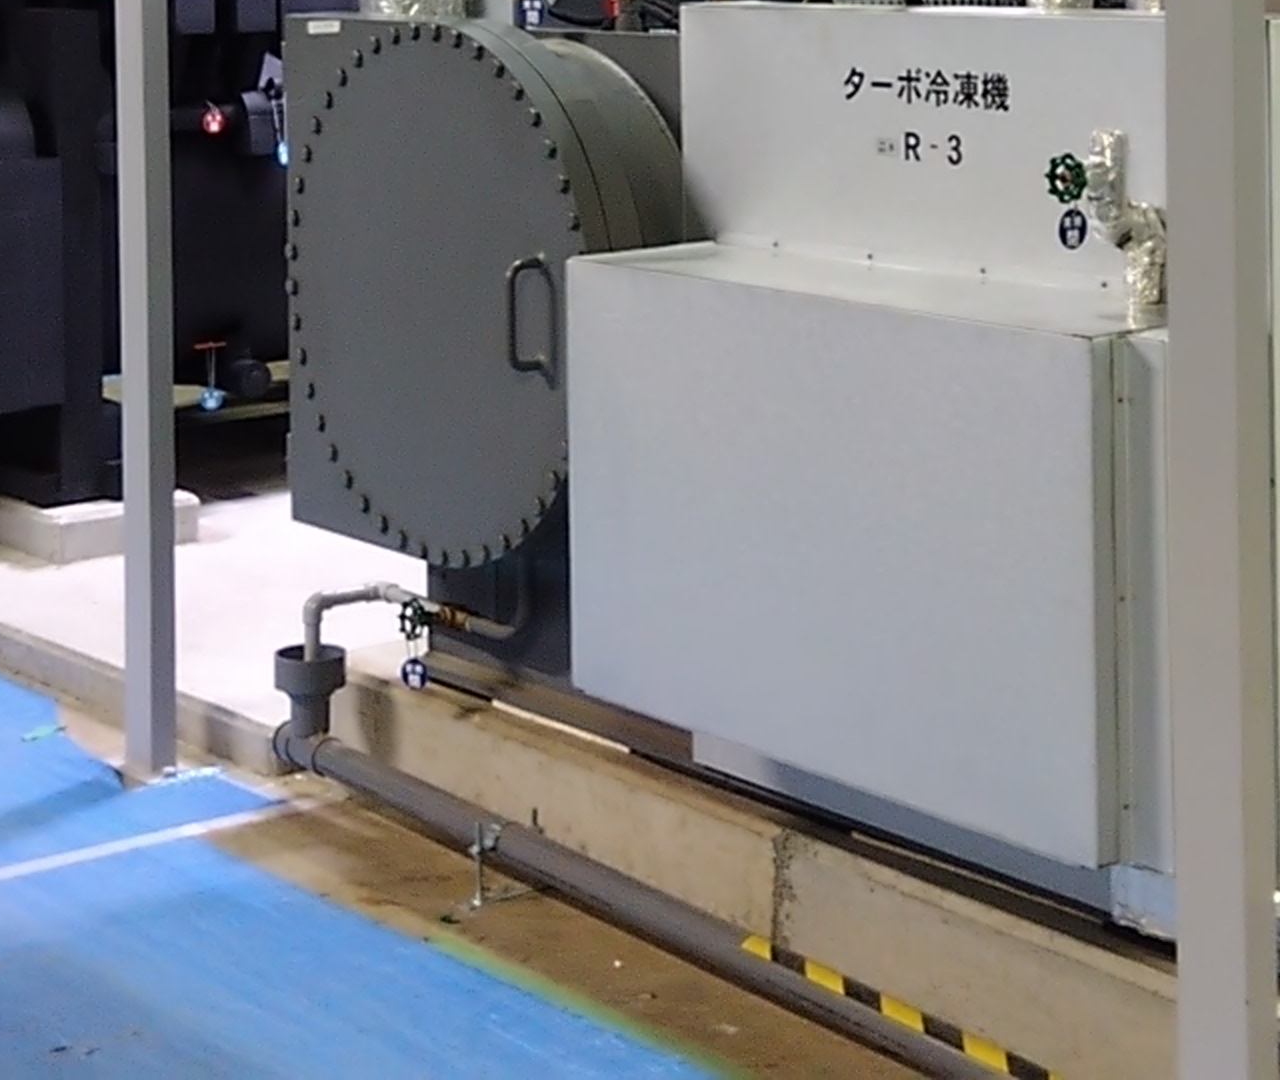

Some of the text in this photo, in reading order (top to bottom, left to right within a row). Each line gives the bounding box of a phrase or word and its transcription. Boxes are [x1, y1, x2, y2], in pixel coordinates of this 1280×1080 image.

[843, 66, 1010, 112] ターボ冷凍機
